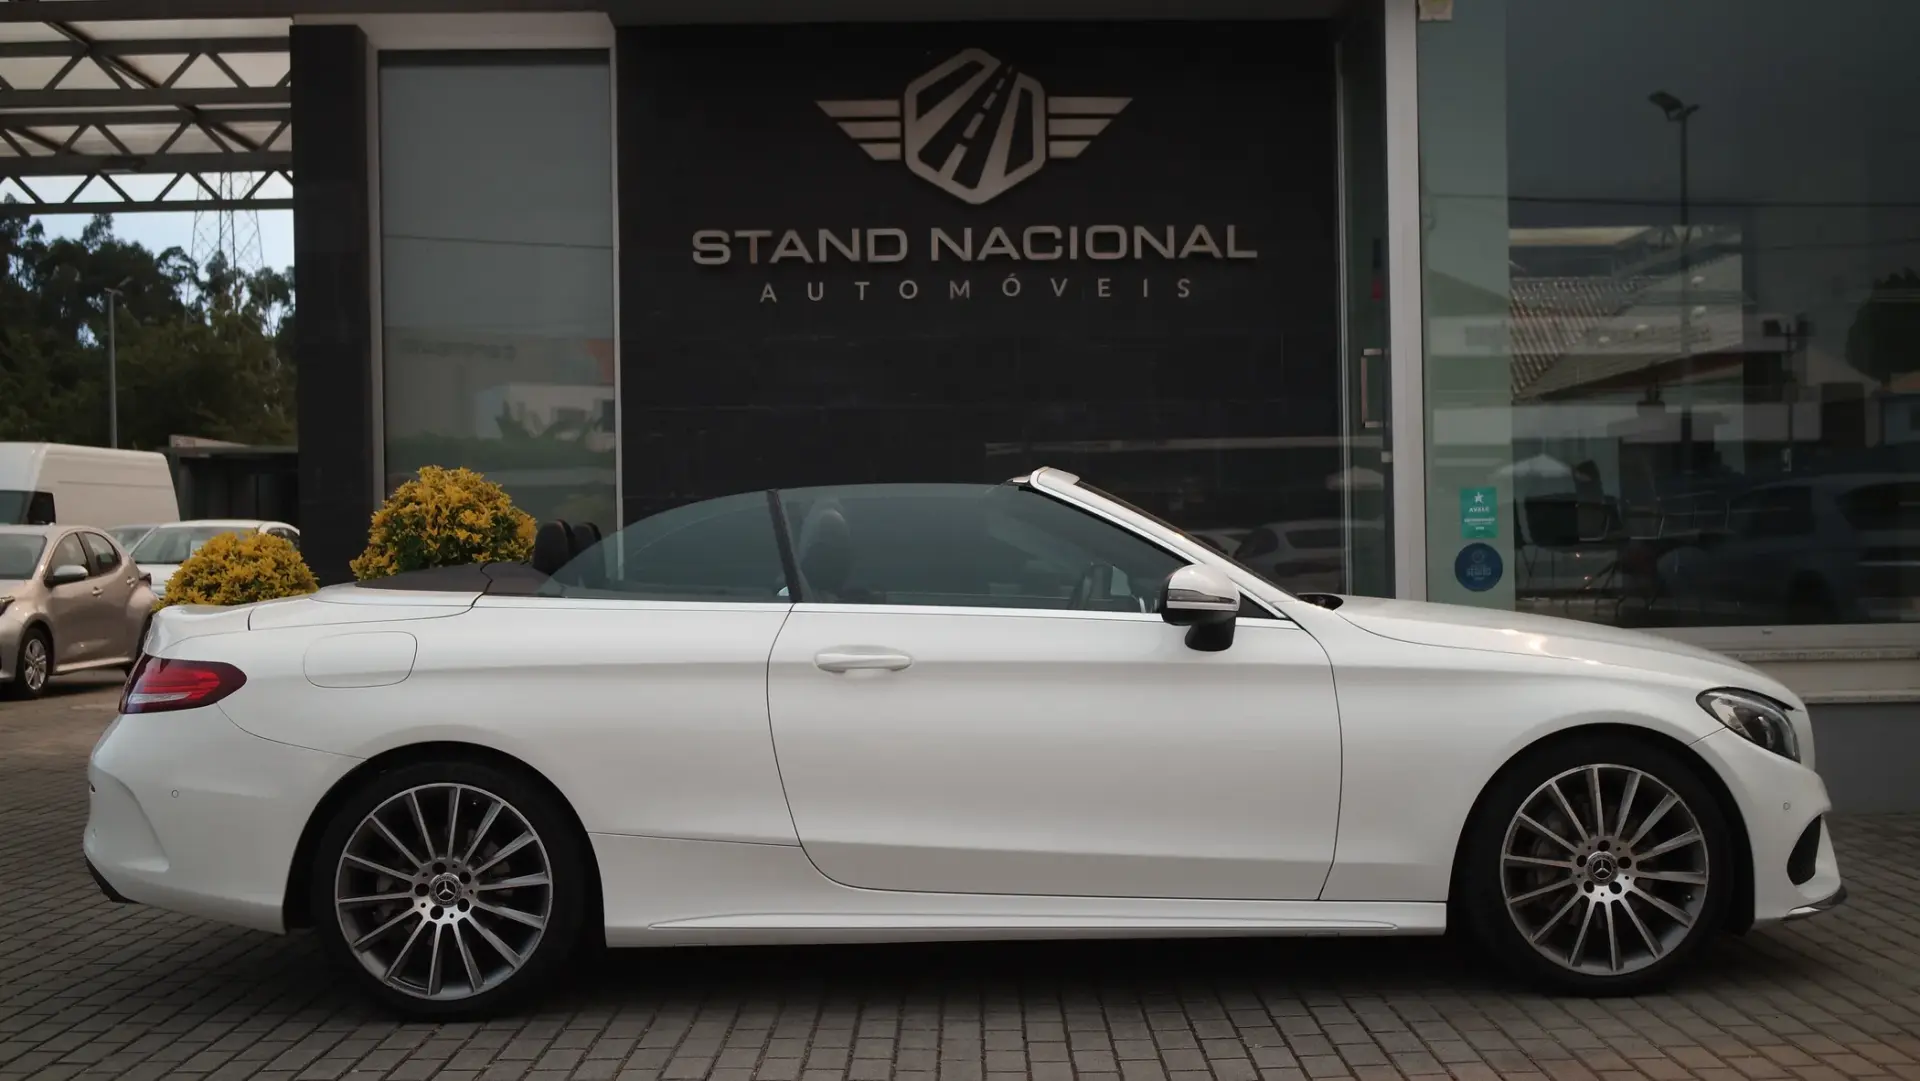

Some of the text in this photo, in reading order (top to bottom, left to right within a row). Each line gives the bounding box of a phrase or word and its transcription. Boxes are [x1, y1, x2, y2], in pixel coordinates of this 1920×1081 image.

[692, 224, 1258, 265] STAND NACIONAL
[759, 273, 1191, 302] AUTOMÓVEIS
